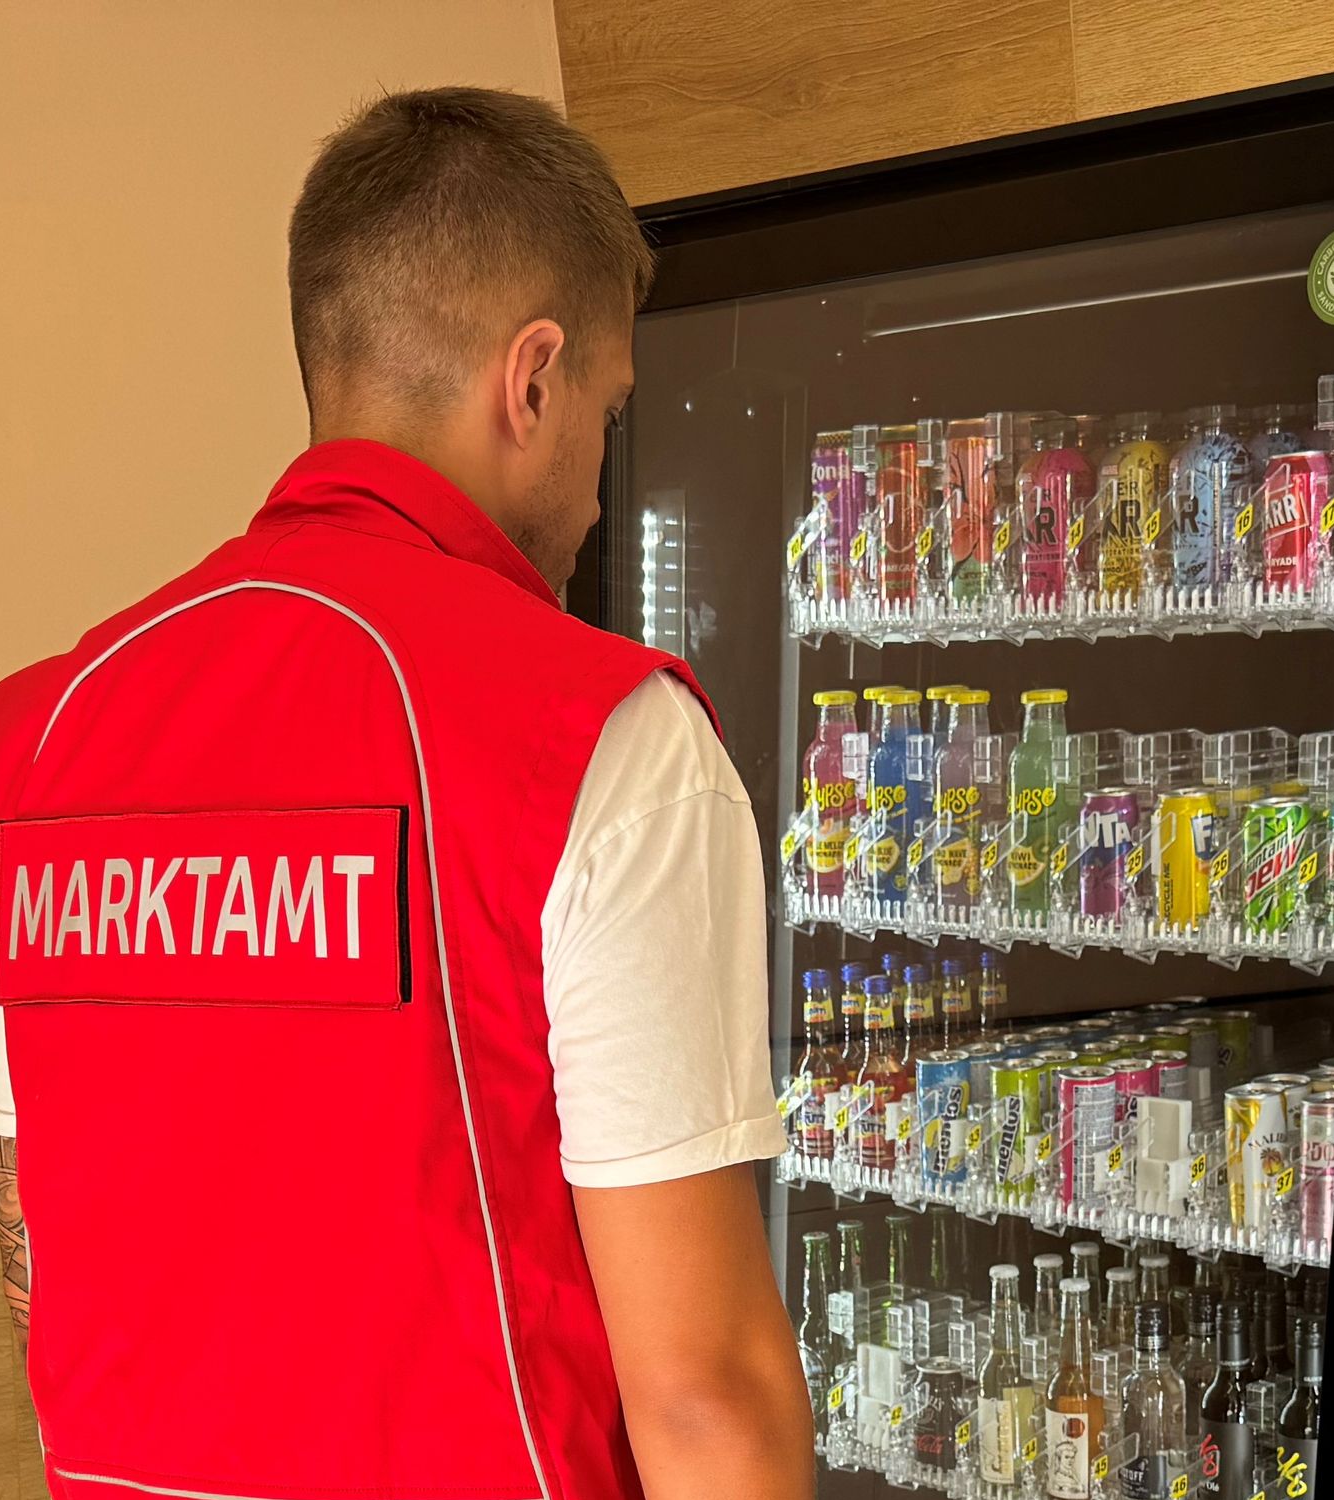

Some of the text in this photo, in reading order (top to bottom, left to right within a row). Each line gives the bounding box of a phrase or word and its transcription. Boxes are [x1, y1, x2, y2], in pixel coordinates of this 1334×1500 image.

[1237, 512, 1250, 532] 16
[1322, 503, 1334, 525] 17
[1069, 523, 1081, 543] 14
[1146, 517, 1158, 537] 15
[996, 528, 1009, 548] 13
[1128, 853, 1141, 874] 25
[1214, 855, 1228, 876] 26
[1300, 859, 1315, 881] 27
[8, 854, 375, 961] MARKTAMT
[1108, 1148, 1121, 1167] 35
[1191, 1158, 1205, 1178] 36
[1277, 1171, 1291, 1192] 37
[1095, 1457, 1107, 1474] 45
[1173, 1478, 1186, 1494] 46
